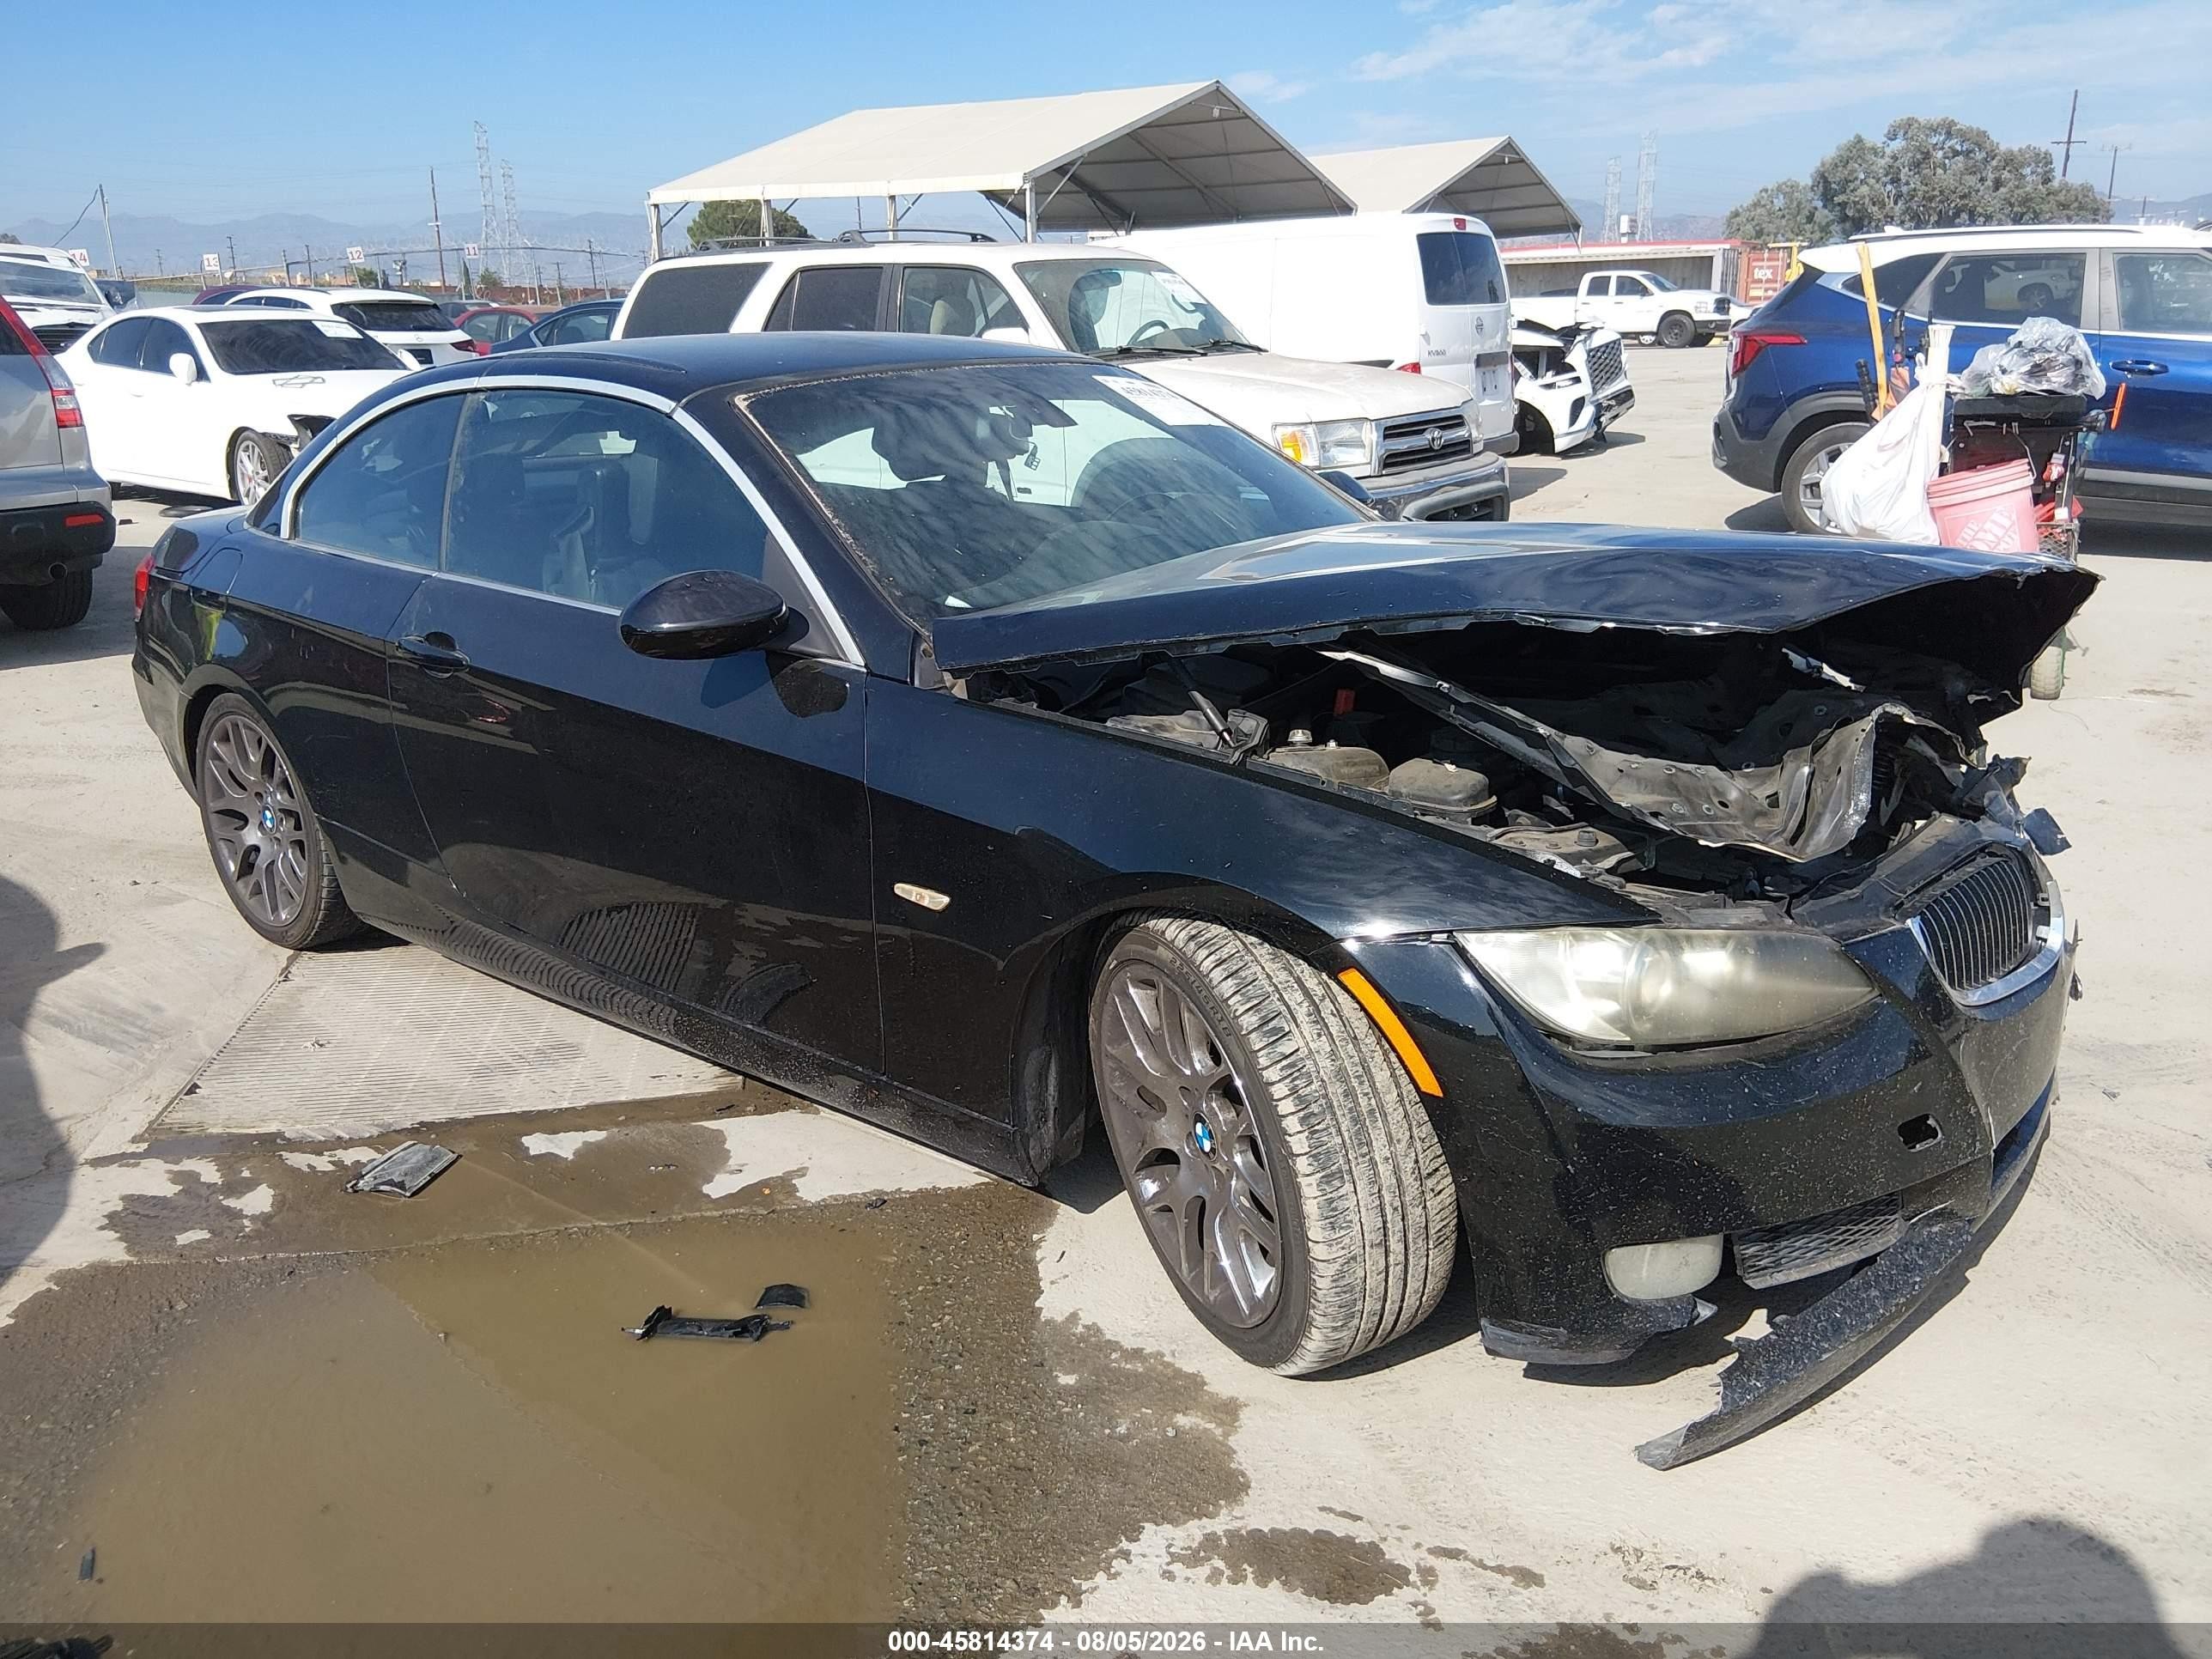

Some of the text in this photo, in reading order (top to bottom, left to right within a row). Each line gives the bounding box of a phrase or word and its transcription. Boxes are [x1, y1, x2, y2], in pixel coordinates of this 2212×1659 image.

[349, 250, 362, 260] 12
[466, 246, 478, 256] 11
[205, 257, 218, 267] 13
[1753, 267, 1773, 280] tex
